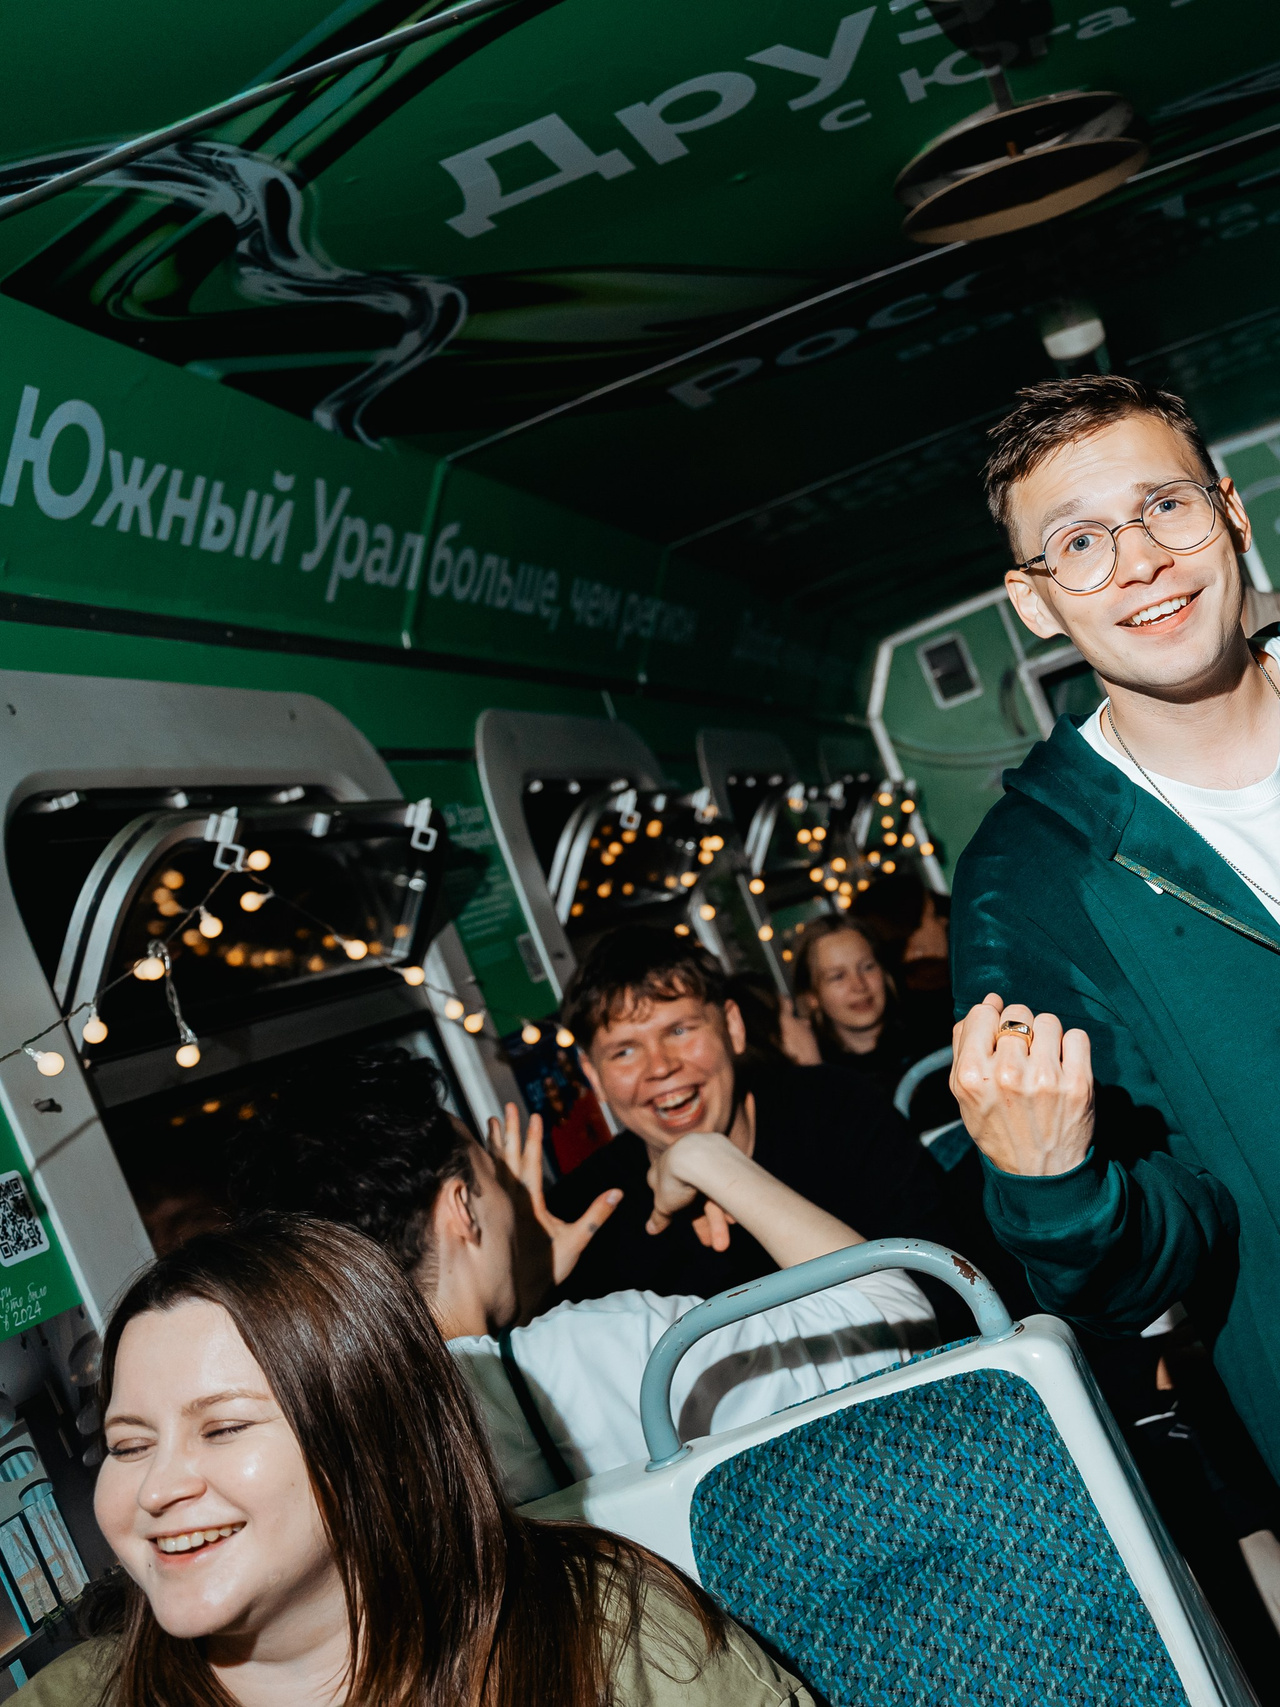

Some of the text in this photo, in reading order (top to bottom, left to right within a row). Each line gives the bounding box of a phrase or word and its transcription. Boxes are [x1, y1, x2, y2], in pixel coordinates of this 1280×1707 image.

[437, 0, 990, 239] Друз
[1, 384, 296, 566] Южный
[300, 477, 427, 604] Урал
[428, 521, 561, 632] больше,
[570, 577, 621, 630] чем
[13, 1300, 42, 1327] 2024
